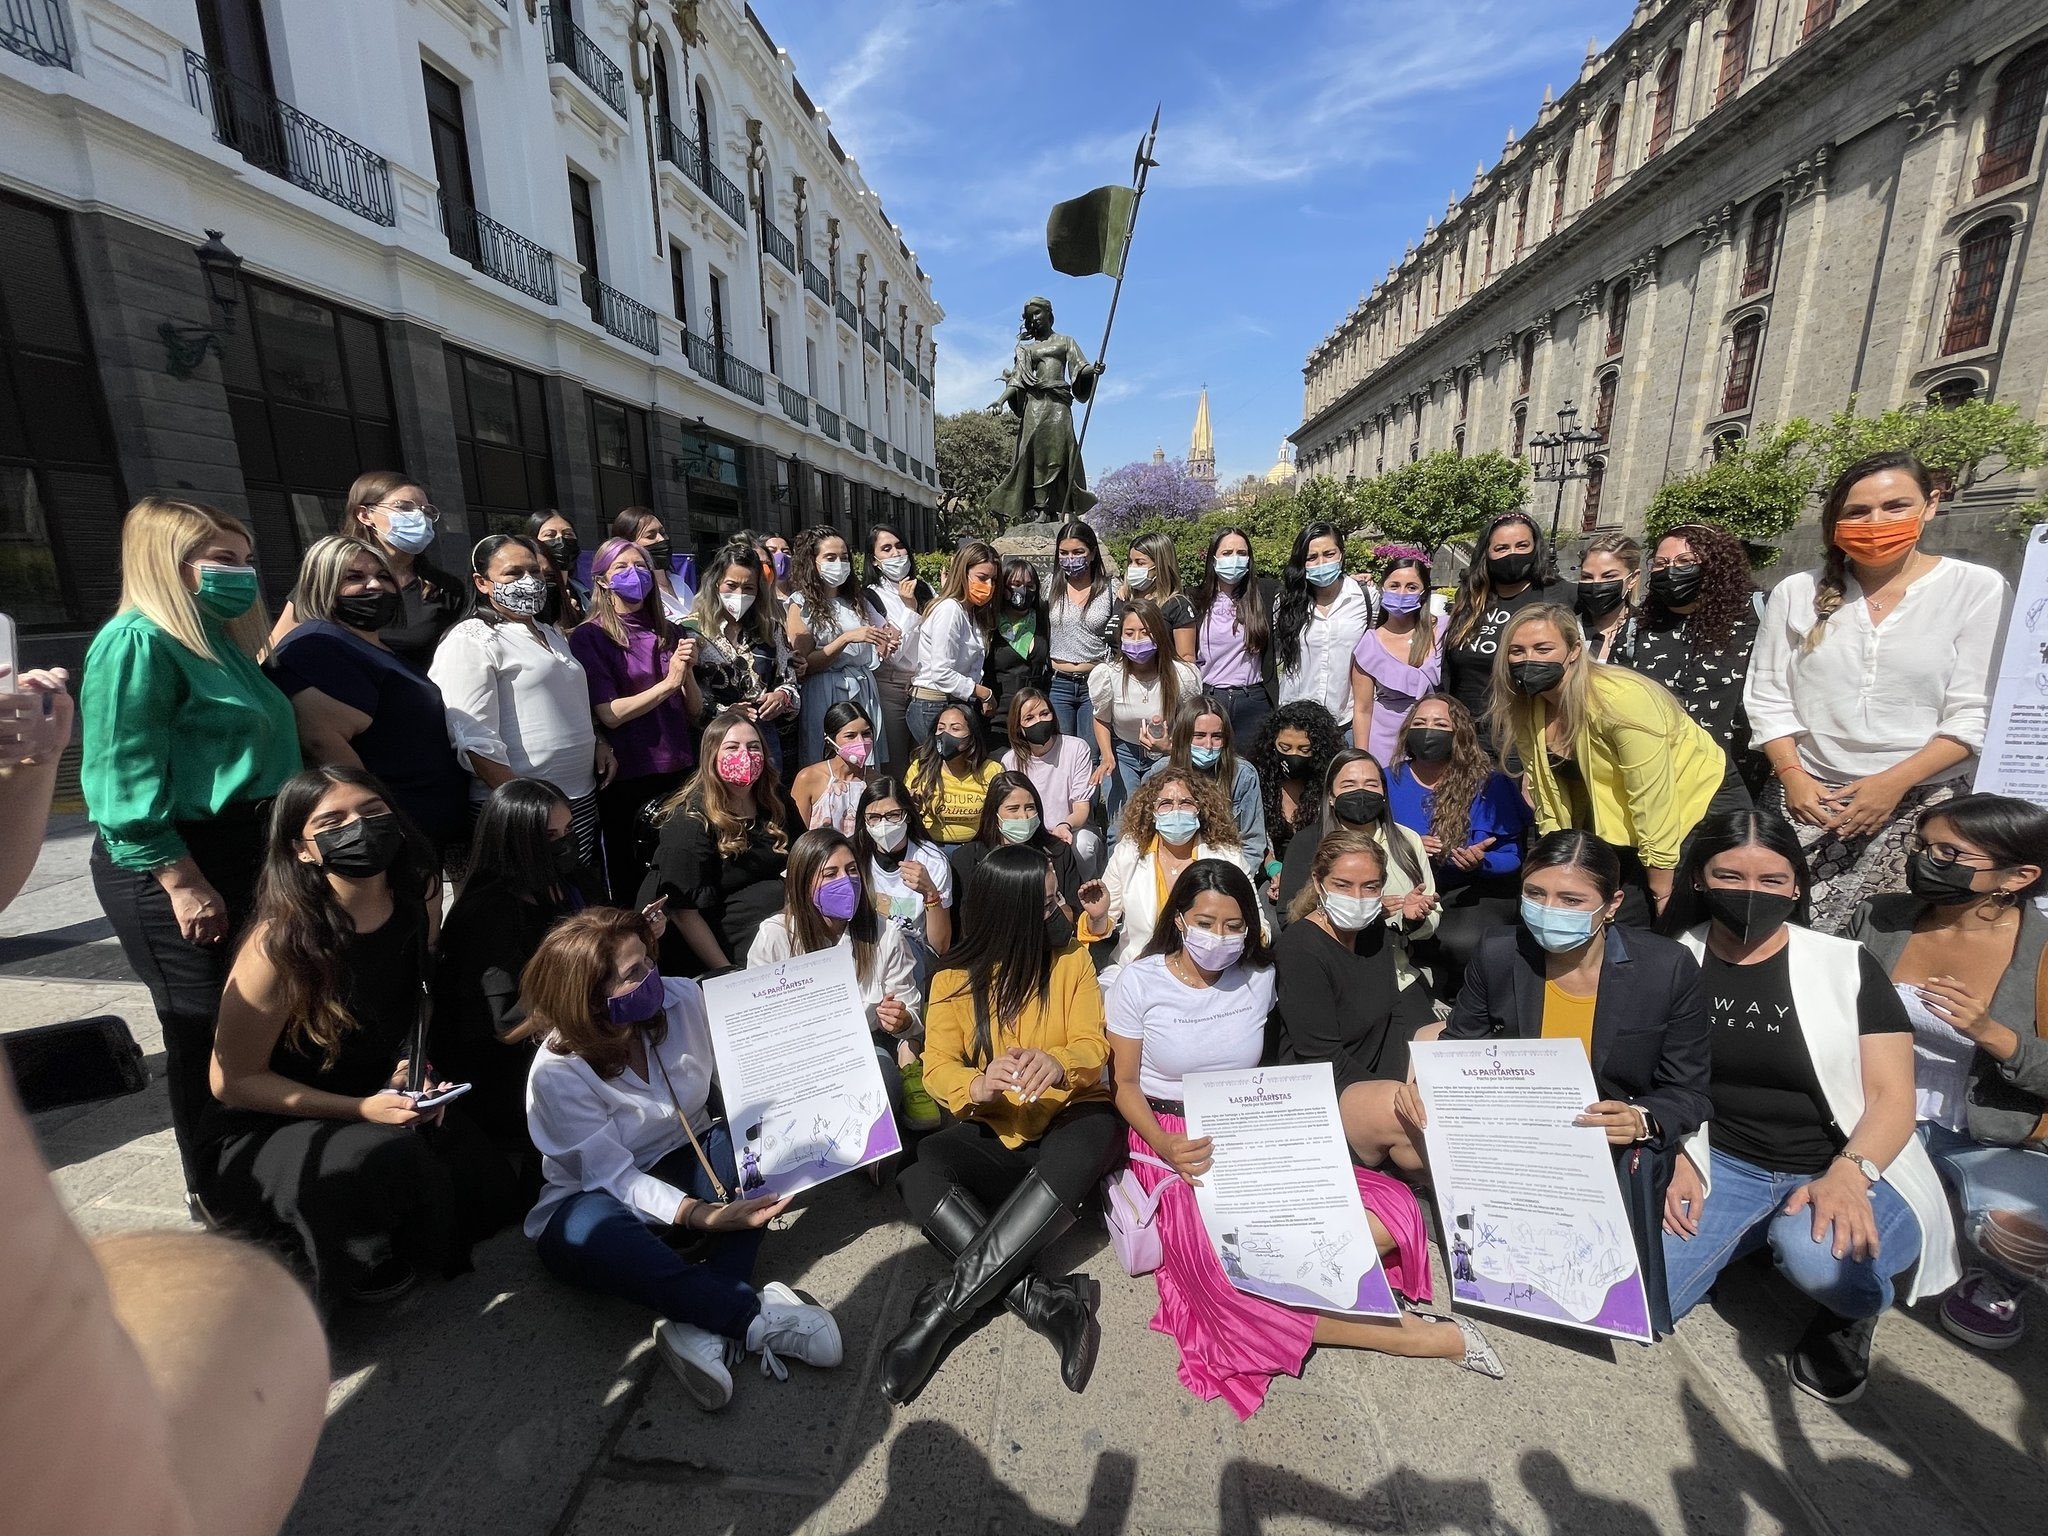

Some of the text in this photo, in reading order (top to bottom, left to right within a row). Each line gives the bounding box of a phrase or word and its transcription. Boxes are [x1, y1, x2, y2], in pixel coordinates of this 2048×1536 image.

[945, 794, 984, 804] UTURA
[1714, 996, 1790, 1019] WAY
[1711, 1015, 1780, 1034] REAM
[1461, 1068, 1536, 1076] LAS PARITARISTAS
[1229, 1096, 1244, 1104] LAS
